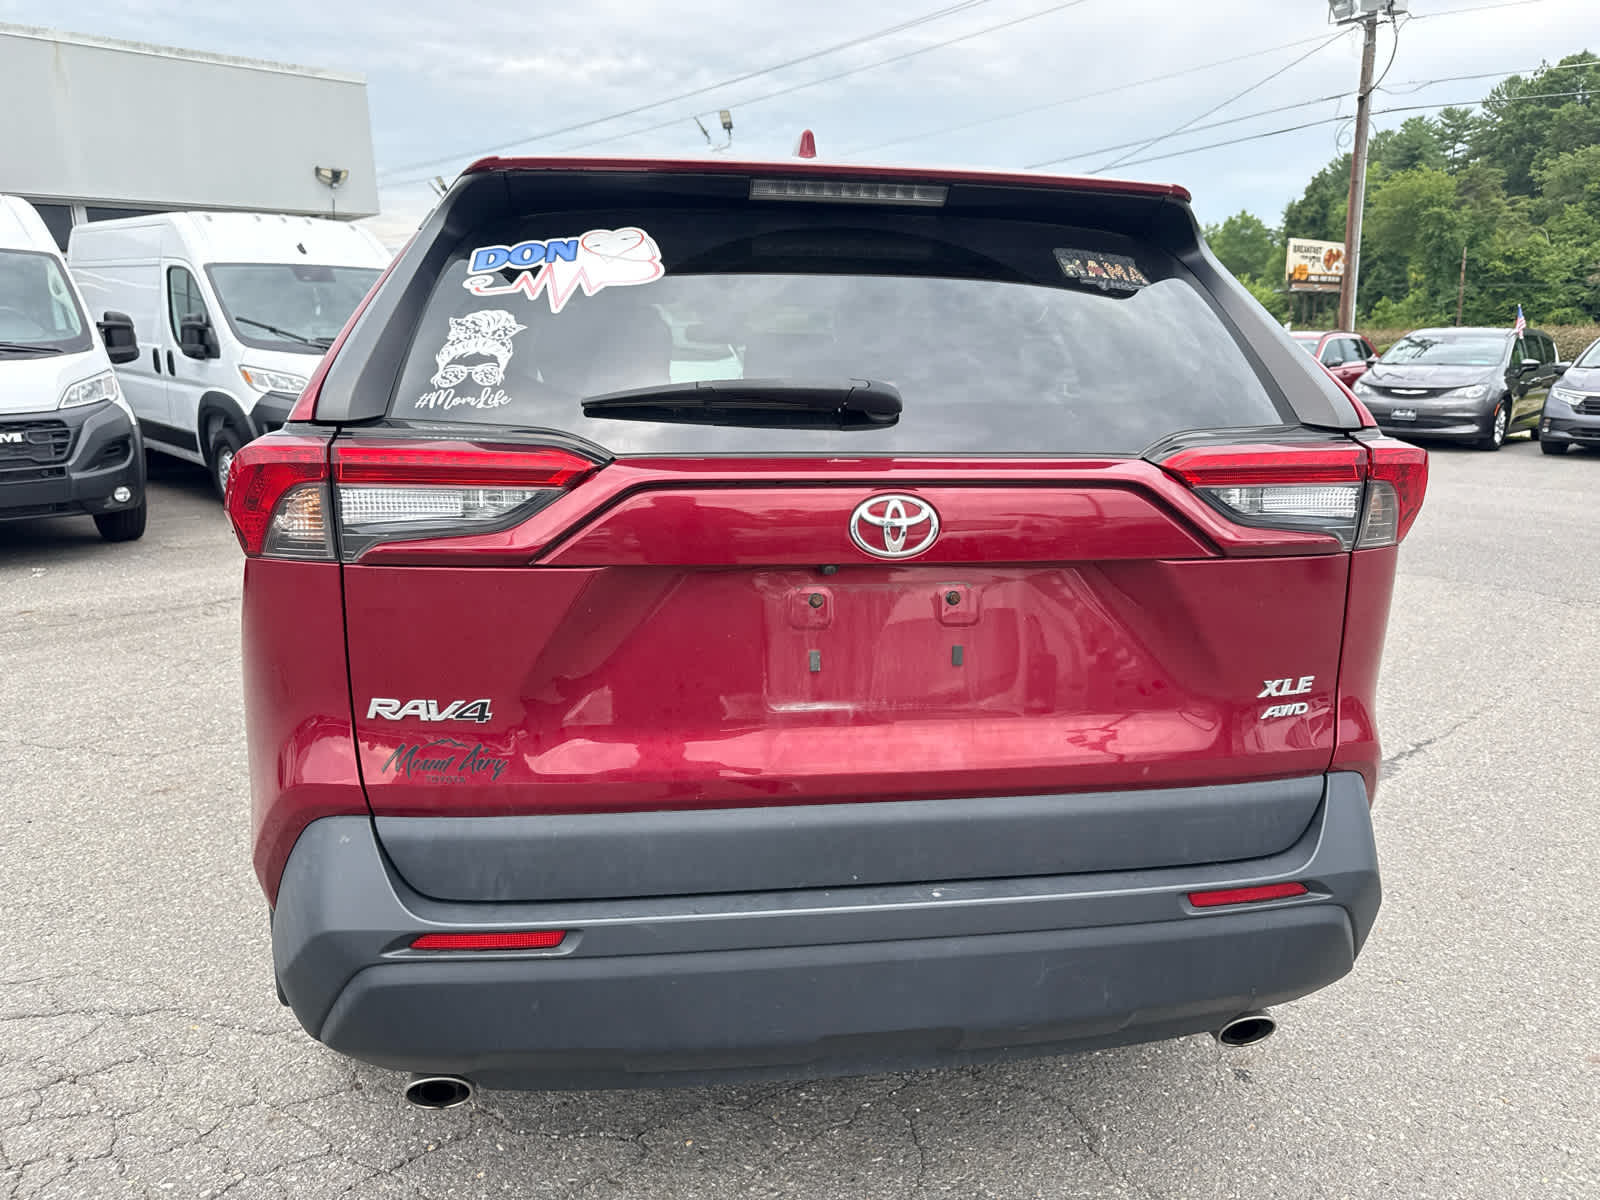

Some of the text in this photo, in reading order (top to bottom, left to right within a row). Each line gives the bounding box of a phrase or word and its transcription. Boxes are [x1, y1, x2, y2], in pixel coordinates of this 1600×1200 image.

[472, 240, 579, 272] DON
[414, 387, 512, 410] #MomLife
[1256, 675, 1316, 699] XLE
[366, 697, 493, 724] RAV4
[1260, 702, 1309, 720] AWD
[382, 743, 510, 782] Mount Airy
[426, 775, 467, 784] TOYOTA
